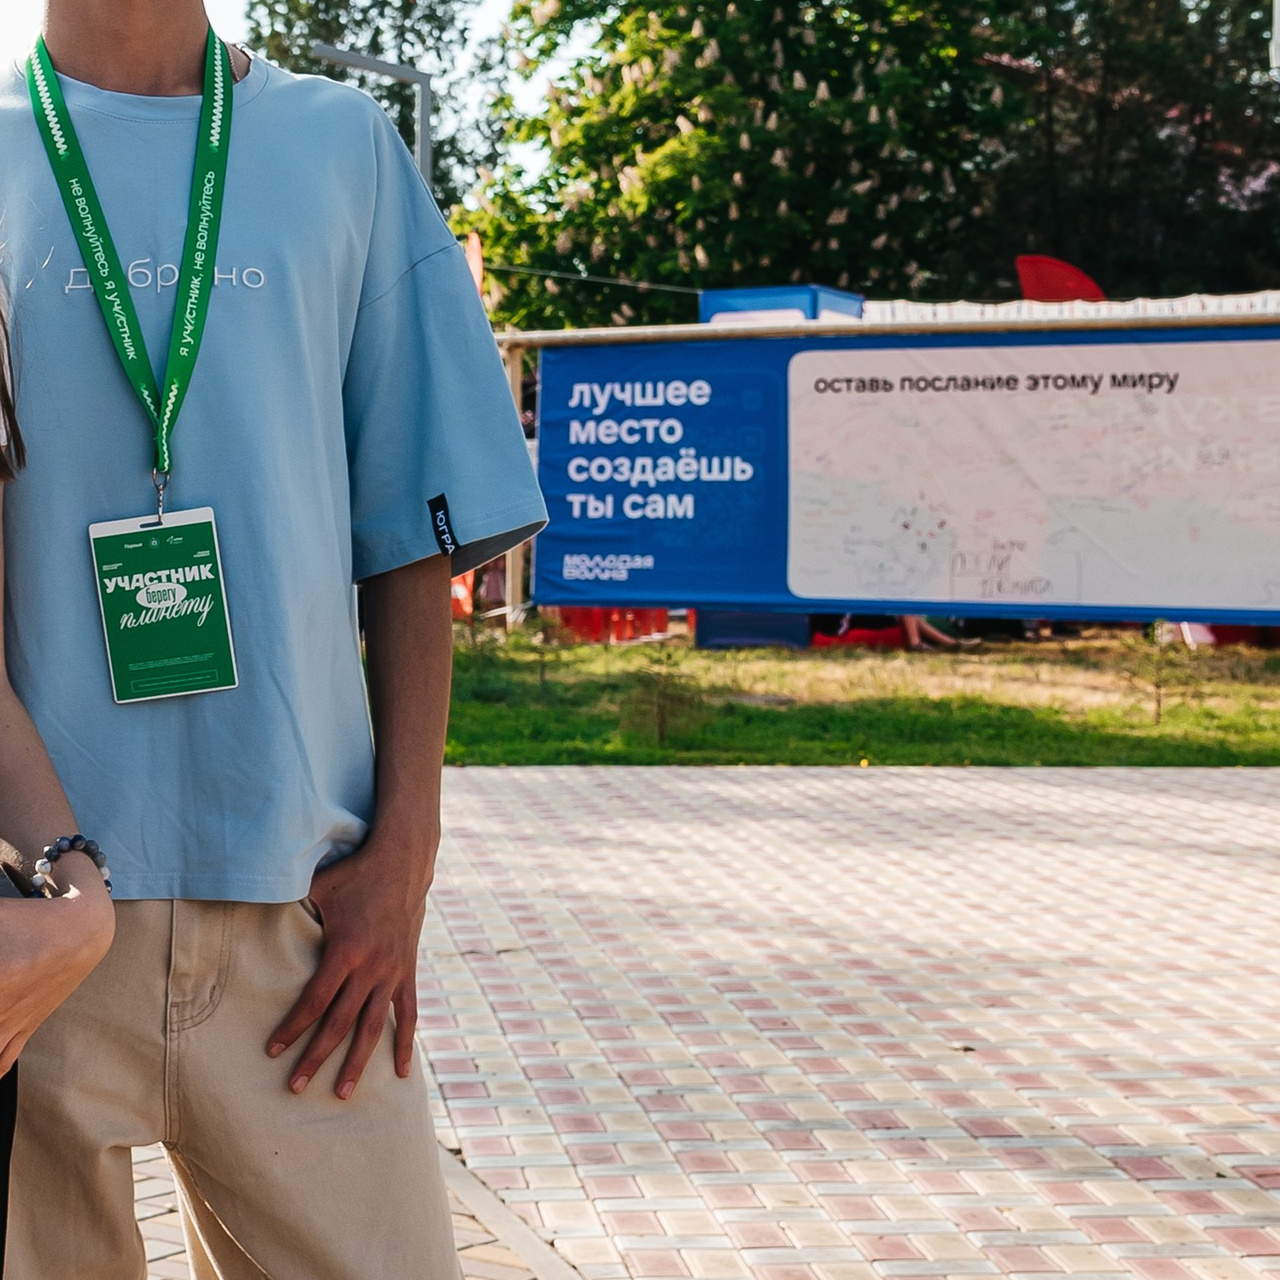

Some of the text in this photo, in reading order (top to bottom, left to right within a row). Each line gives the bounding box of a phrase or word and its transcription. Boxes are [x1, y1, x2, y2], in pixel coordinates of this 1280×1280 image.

[69, 178, 82, 196] не
[196, 171, 216, 250] волнуйтесь
[75, 197, 109, 278] волнуйтесь
[193, 250, 206, 270] не
[104, 281, 114, 291] я
[180, 348, 189, 357] я
[814, 371, 1179, 394] оставь послание этому миру
[568, 380, 712, 415] лучшее
[569, 418, 683, 445] место
[567, 448, 754, 487] создаёшь
[567, 493, 695, 520] ты сам
[435, 510, 456, 555] ЮГРА
[104, 564, 215, 593] УЧАСТНИК
[145, 586, 178, 605] берегу
[120, 594, 215, 630] планету
